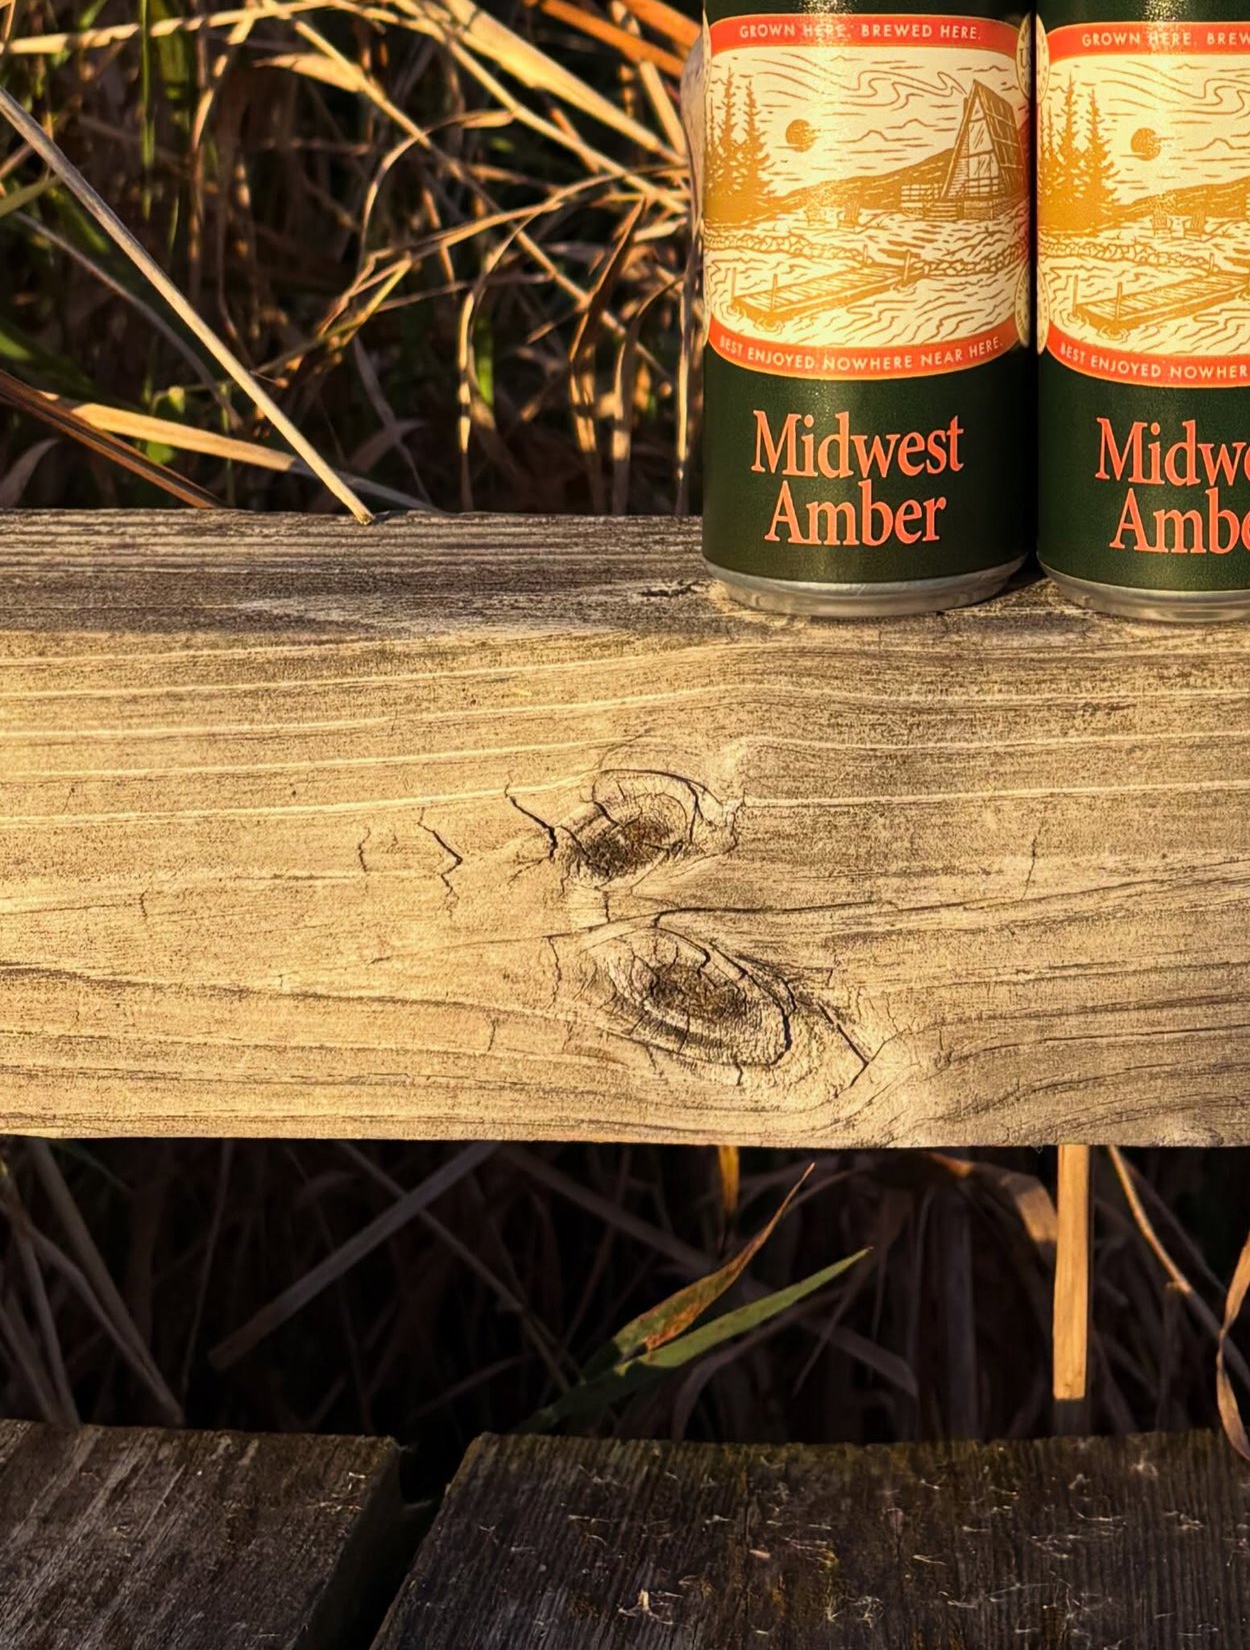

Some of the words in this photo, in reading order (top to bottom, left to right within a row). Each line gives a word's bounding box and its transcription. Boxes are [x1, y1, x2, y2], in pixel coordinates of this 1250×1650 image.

[740, 24, 795, 39] GROWN
[862, 24, 932, 38] BREWED
[940, 25, 981, 40] HERE.
[1082, 32, 1140, 47] GROWN
[1149, 32, 1197, 46] HERE.
[719, 335, 742, 357] BEST
[747, 348, 815, 370] ENJOYED
[823, 354, 912, 371] NOWHERE
[920, 344, 964, 367] NEAR
[968, 337, 1003, 358] HERE.
[1060, 345, 1085, 366] BEST
[1091, 355, 1161, 378] ENJOYED
[750, 410, 965, 478] Midwest
[764, 479, 947, 547] Amber
